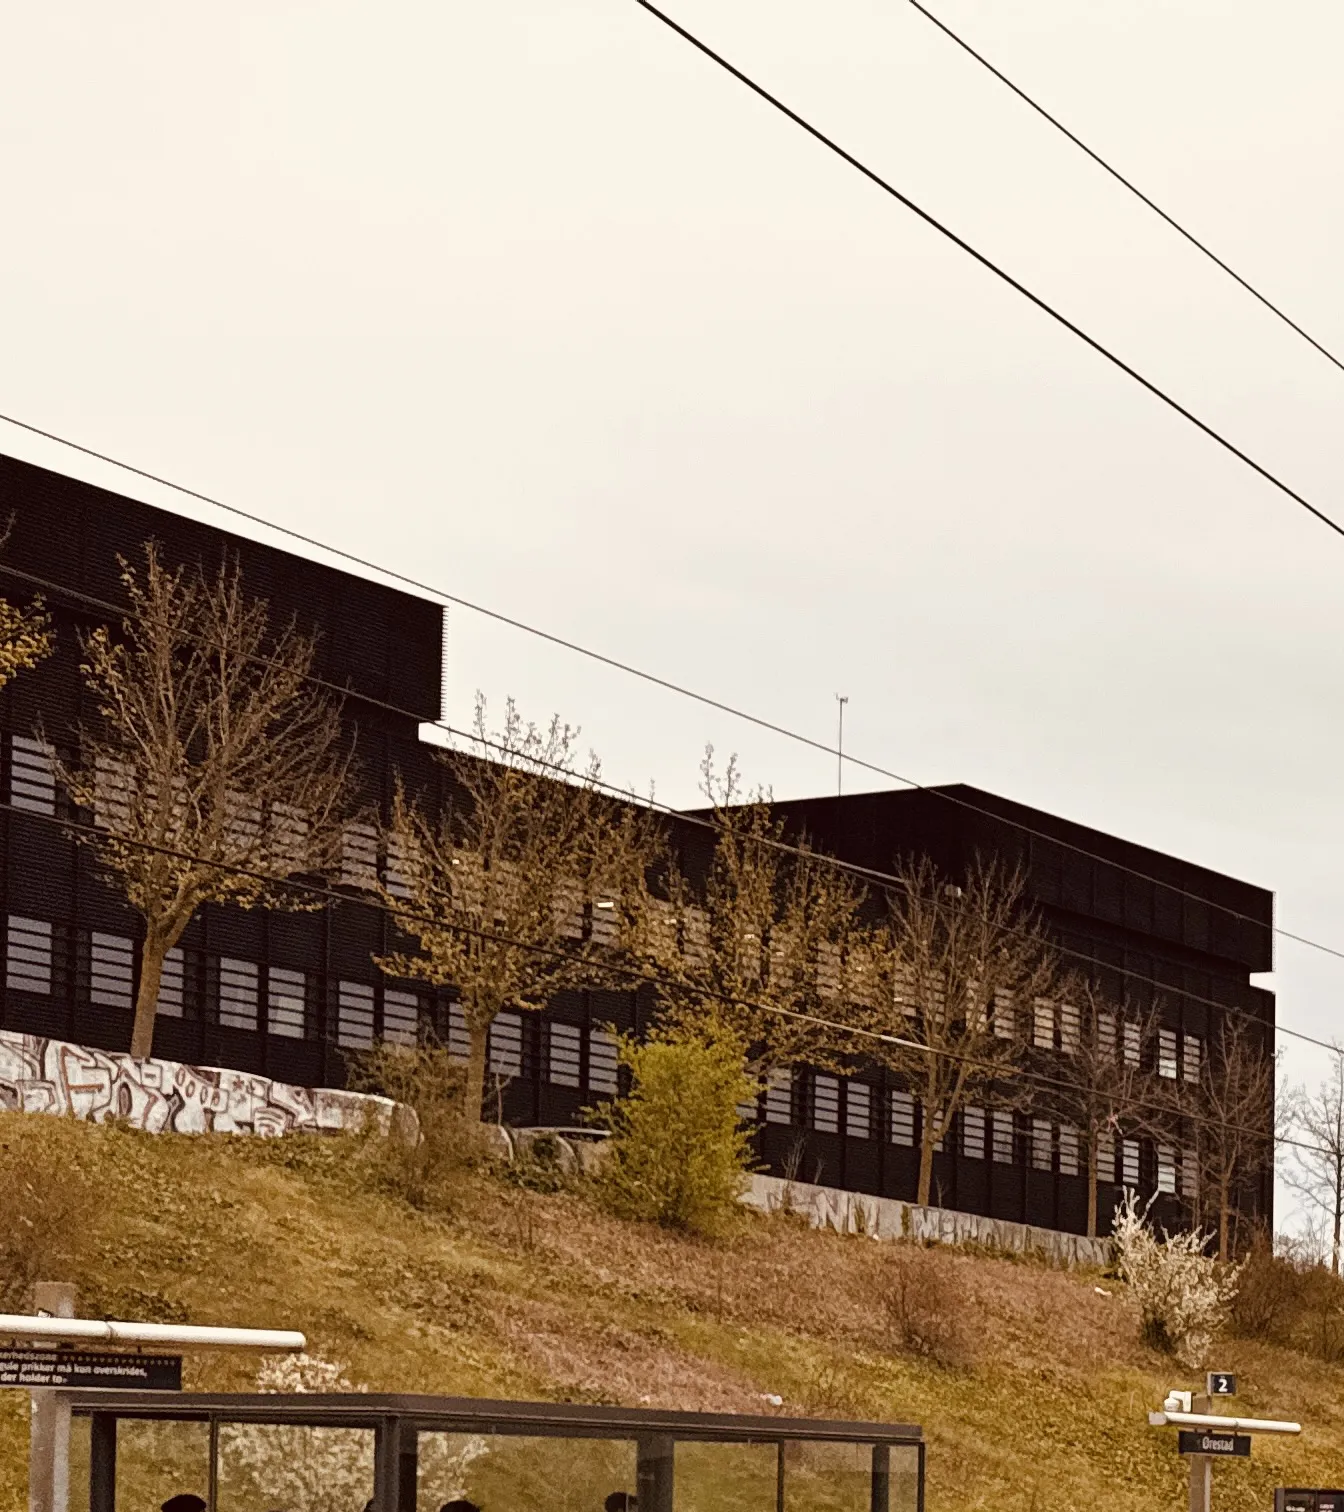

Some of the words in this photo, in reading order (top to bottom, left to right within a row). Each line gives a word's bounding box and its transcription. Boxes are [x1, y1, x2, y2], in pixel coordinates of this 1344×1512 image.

[21, 1361, 56, 1373] prikker
[74, 1363, 92, 1374] kun
[19, 1372, 50, 1383] holder
[1218, 1378, 1229, 1393] 2
[1202, 1435, 1234, 1452] Ørestad
